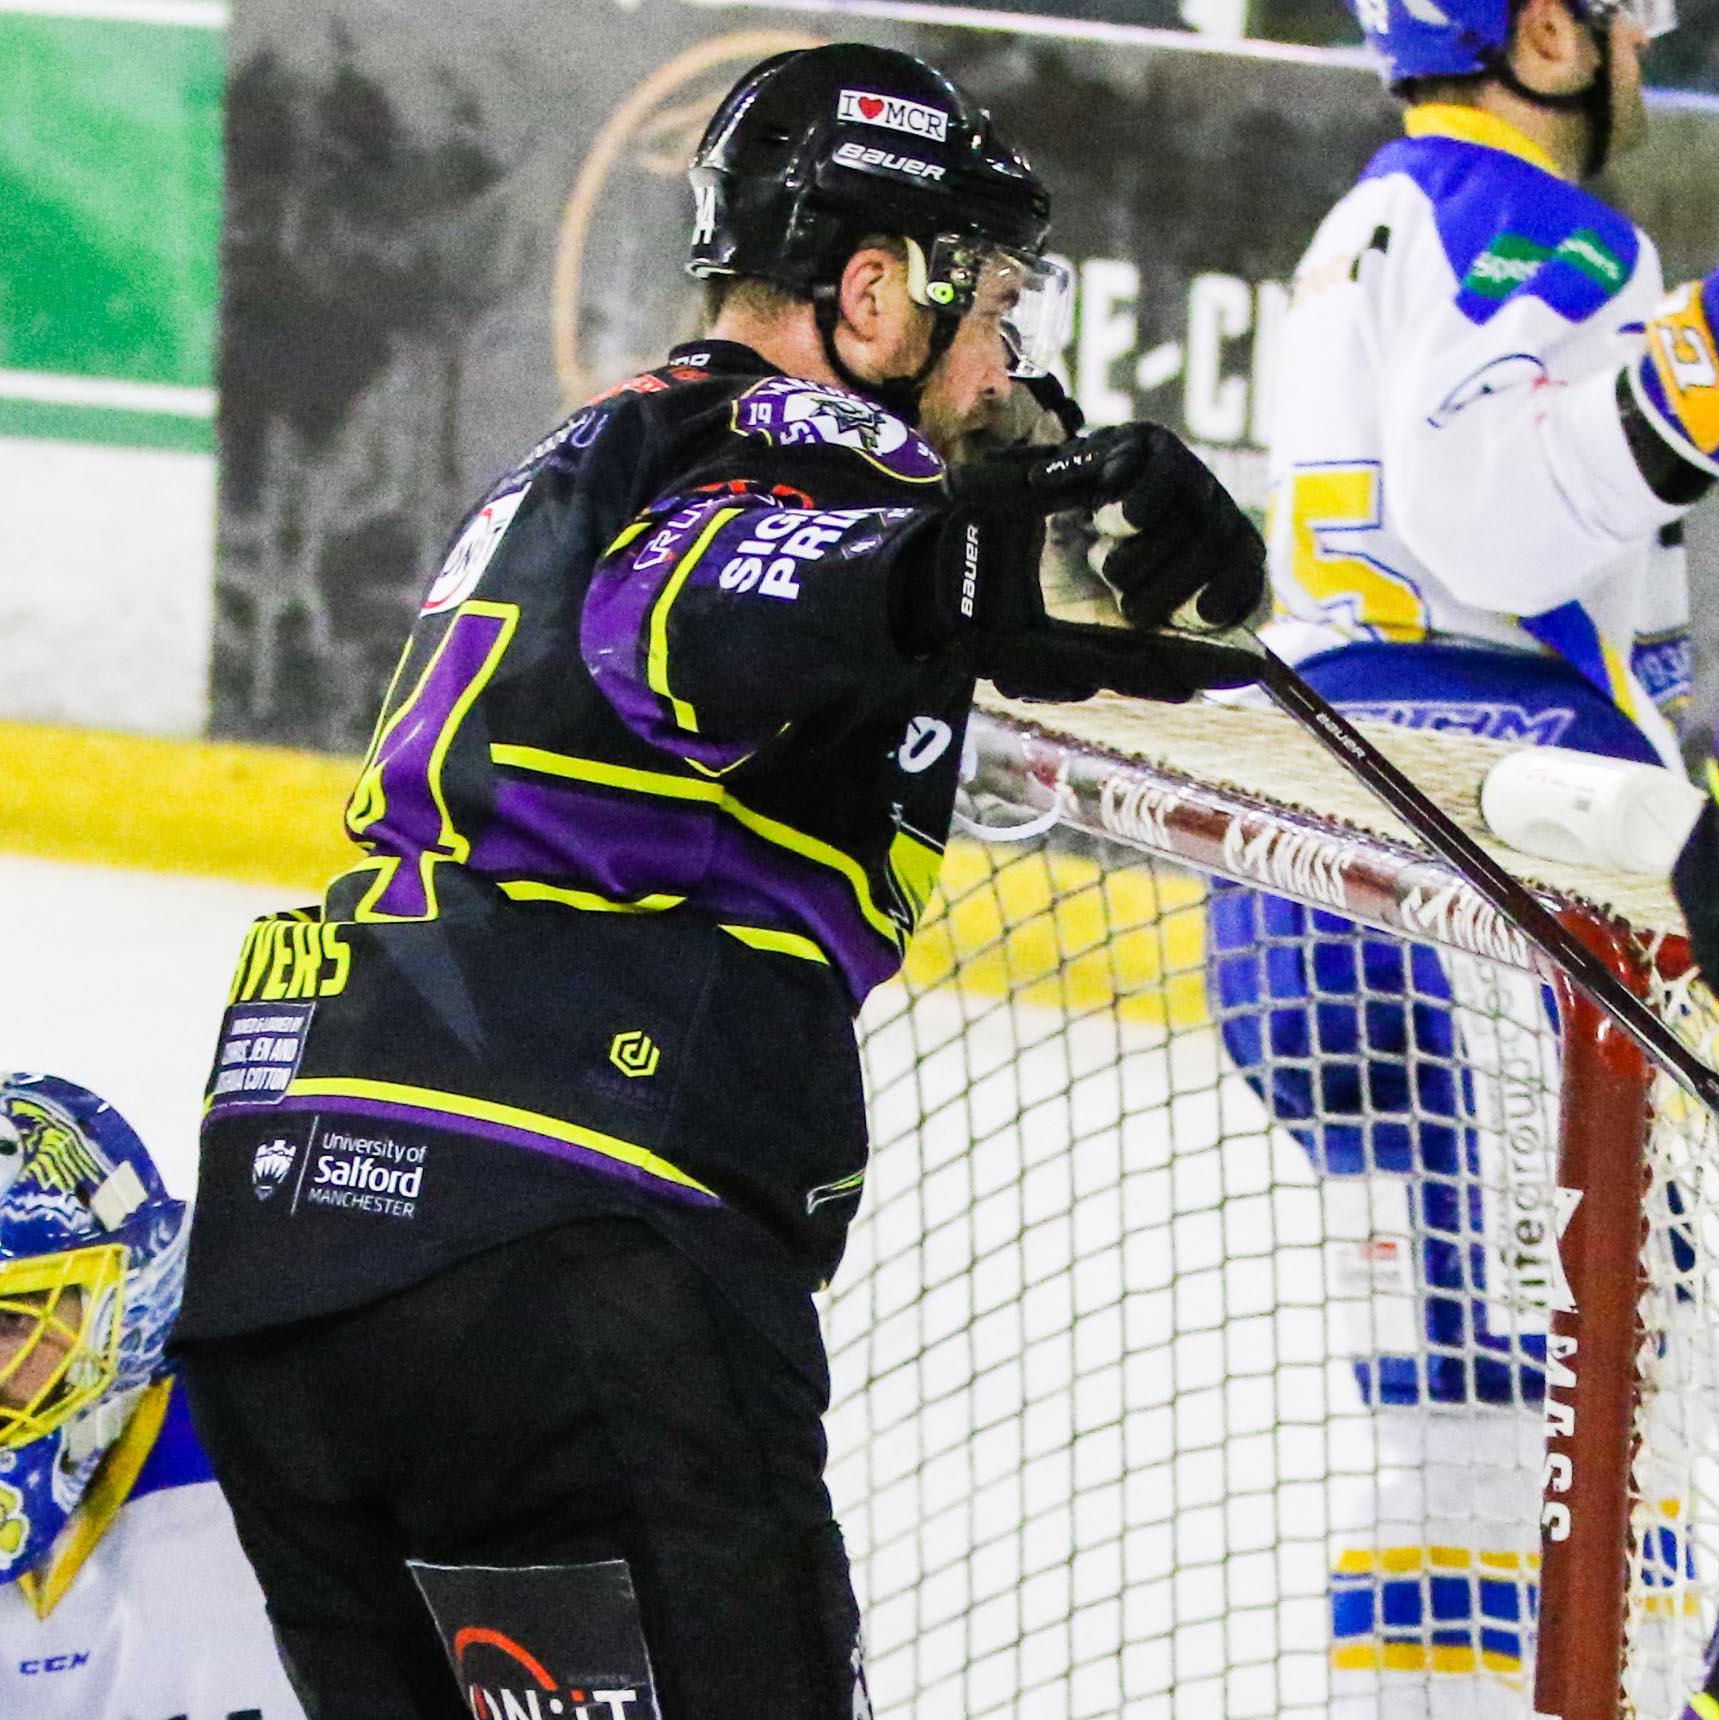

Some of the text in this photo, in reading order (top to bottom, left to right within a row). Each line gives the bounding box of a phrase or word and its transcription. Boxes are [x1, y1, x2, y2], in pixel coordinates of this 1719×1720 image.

[840, 94, 944, 138] I MCR
[322, 1132, 427, 1164] University of
[314, 1155, 423, 1198] Salford
[308, 1188, 415, 1218] MANCHESTER
[19, 1650, 91, 1677] CCM
